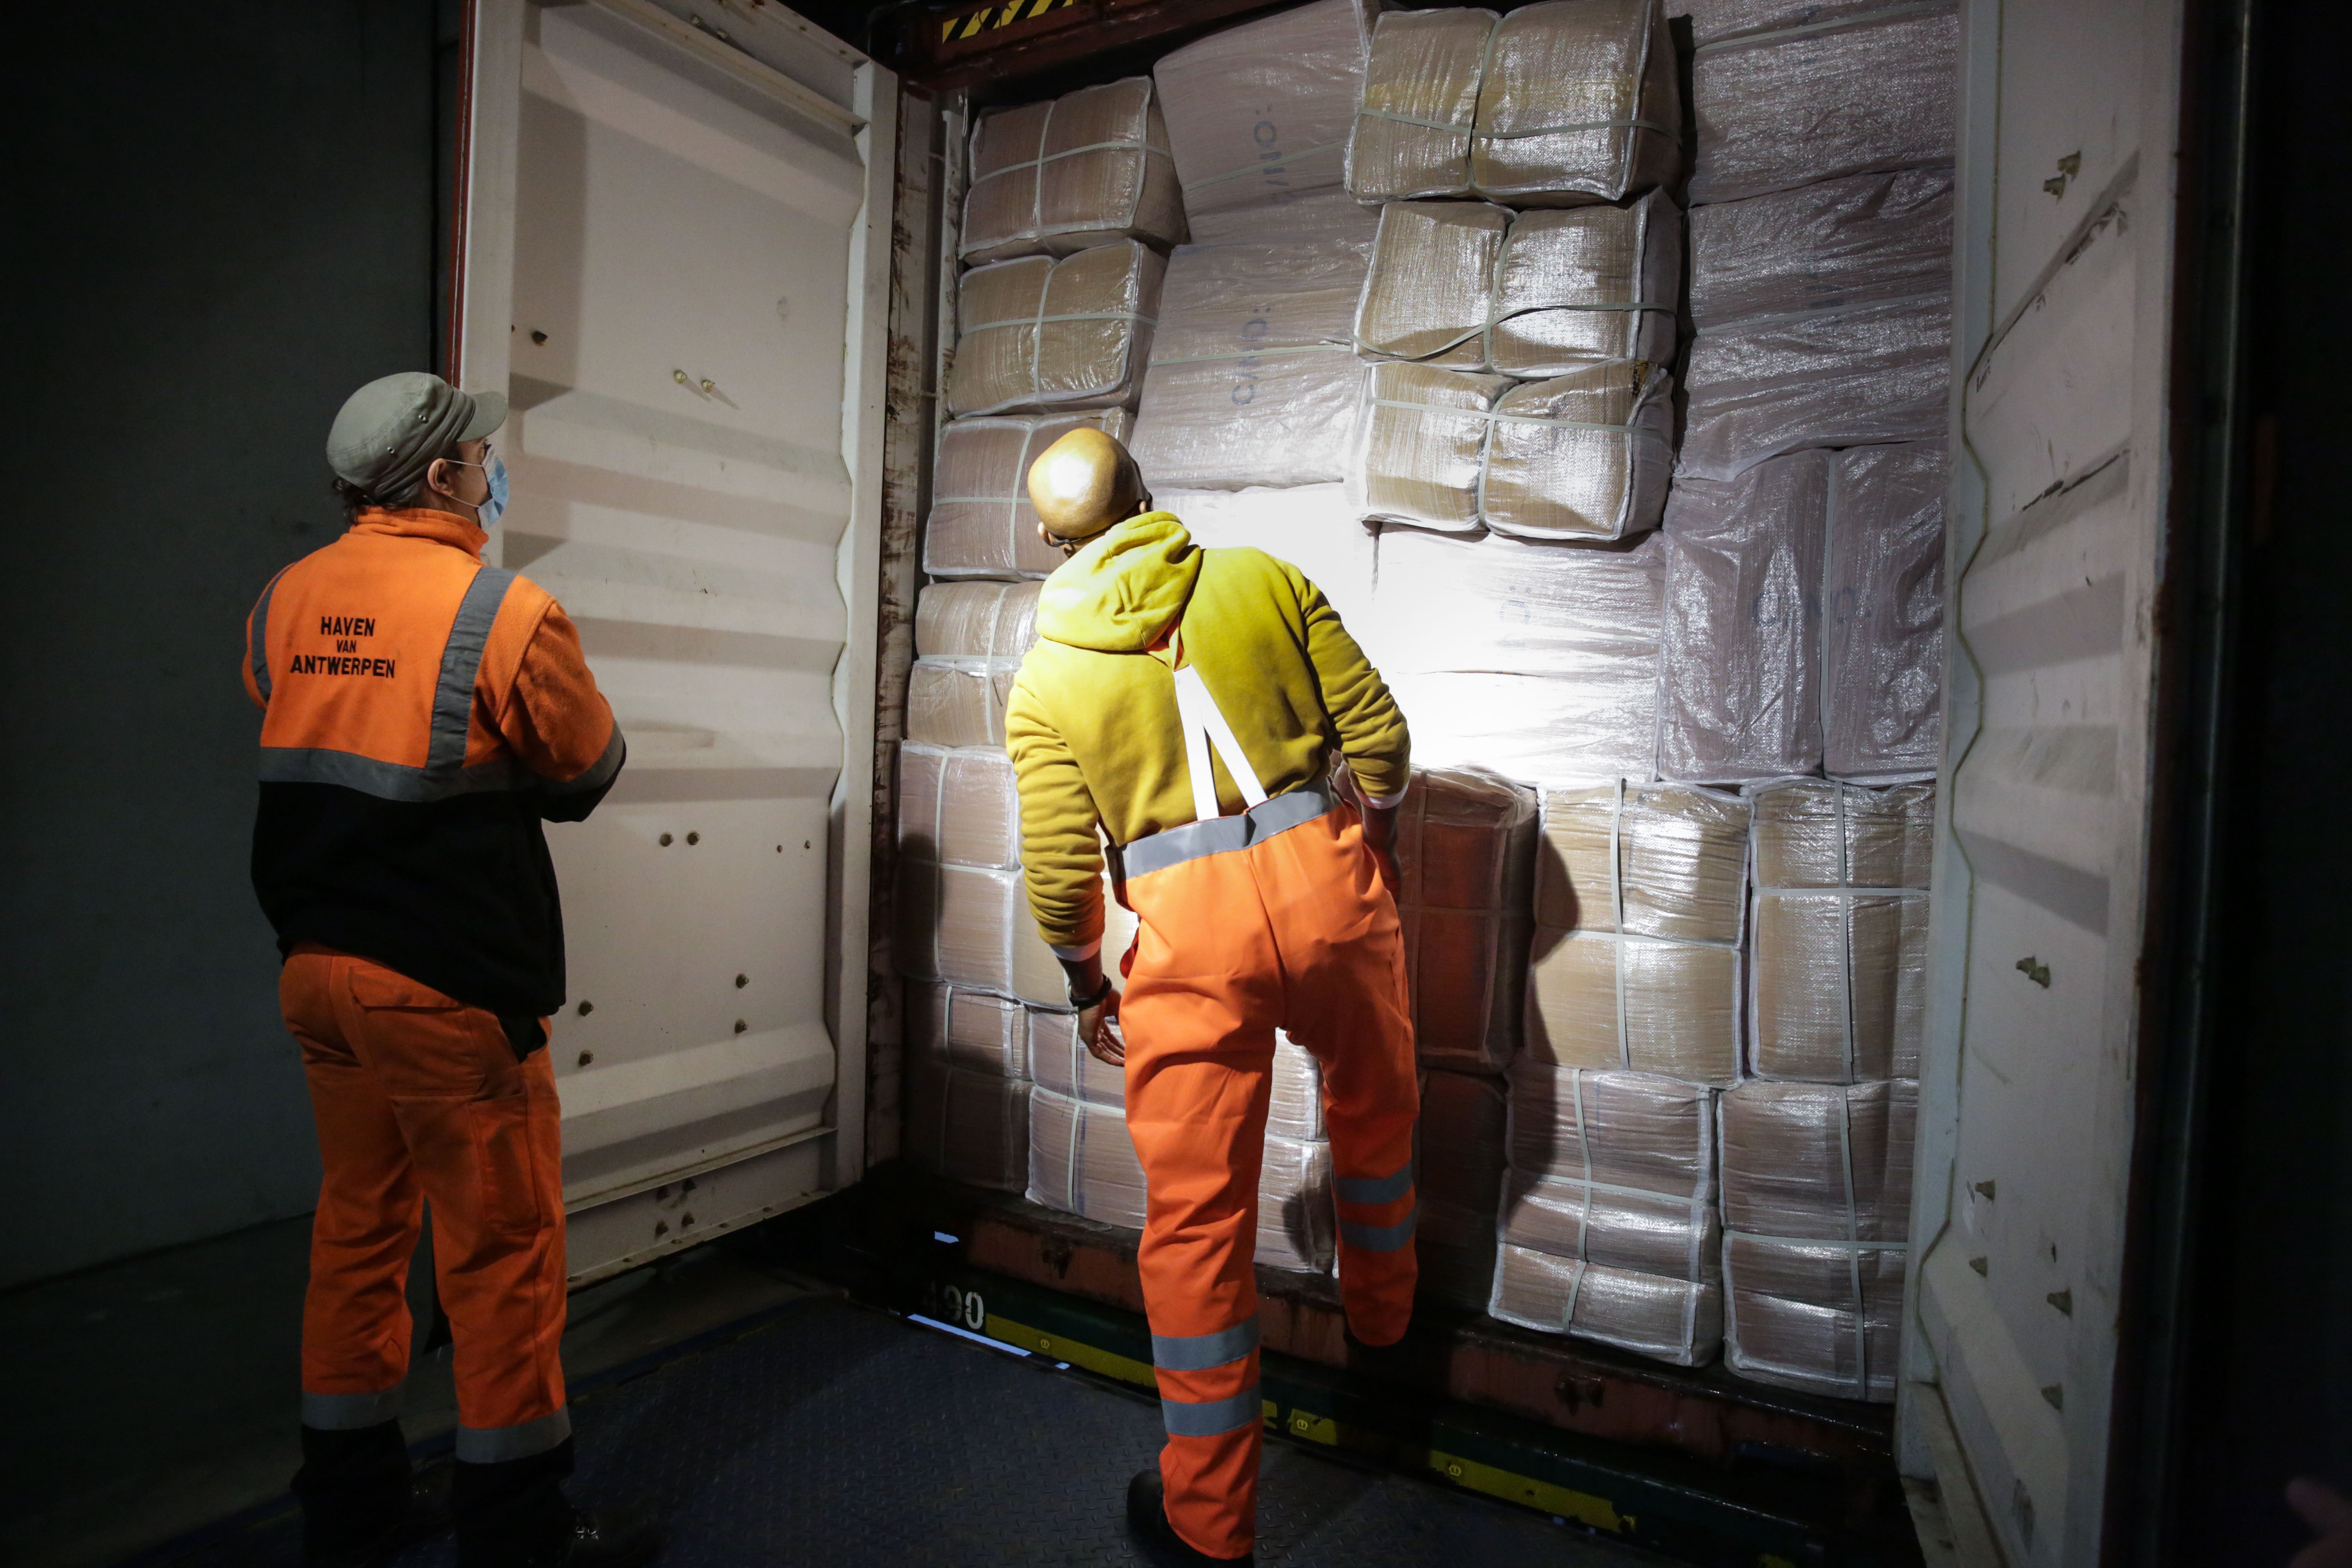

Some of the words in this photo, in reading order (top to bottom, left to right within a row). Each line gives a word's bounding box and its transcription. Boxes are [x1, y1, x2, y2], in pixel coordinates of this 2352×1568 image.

[321, 616, 375, 637] HAVEN
[336, 639, 357, 653] VAN
[290, 655, 396, 679] ANTWERPEN
